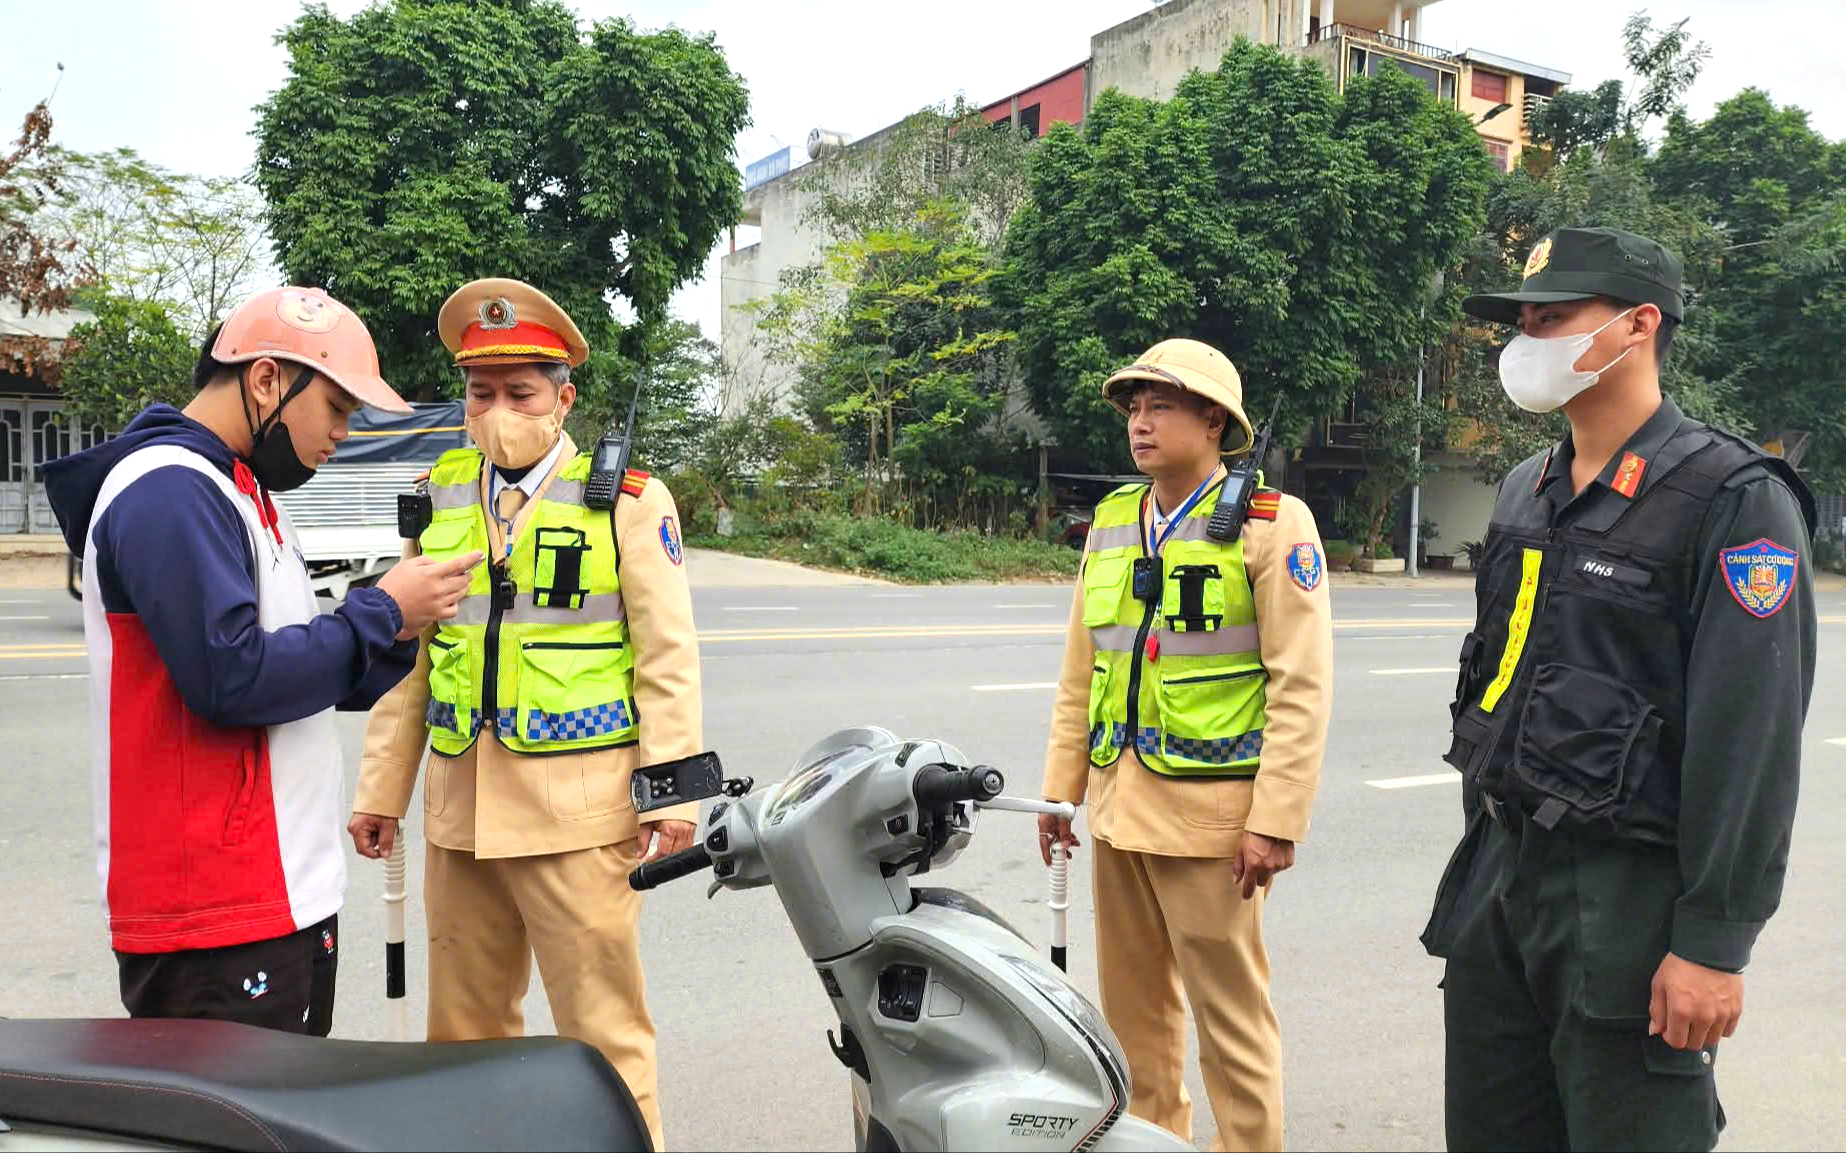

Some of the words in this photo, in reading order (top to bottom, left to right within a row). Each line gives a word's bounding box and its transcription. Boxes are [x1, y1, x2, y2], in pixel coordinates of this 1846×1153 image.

[1584, 561, 1614, 576] NHS
[1008, 1113, 1079, 1130] SPORTY
[1011, 1128, 1066, 1138] EDITION
